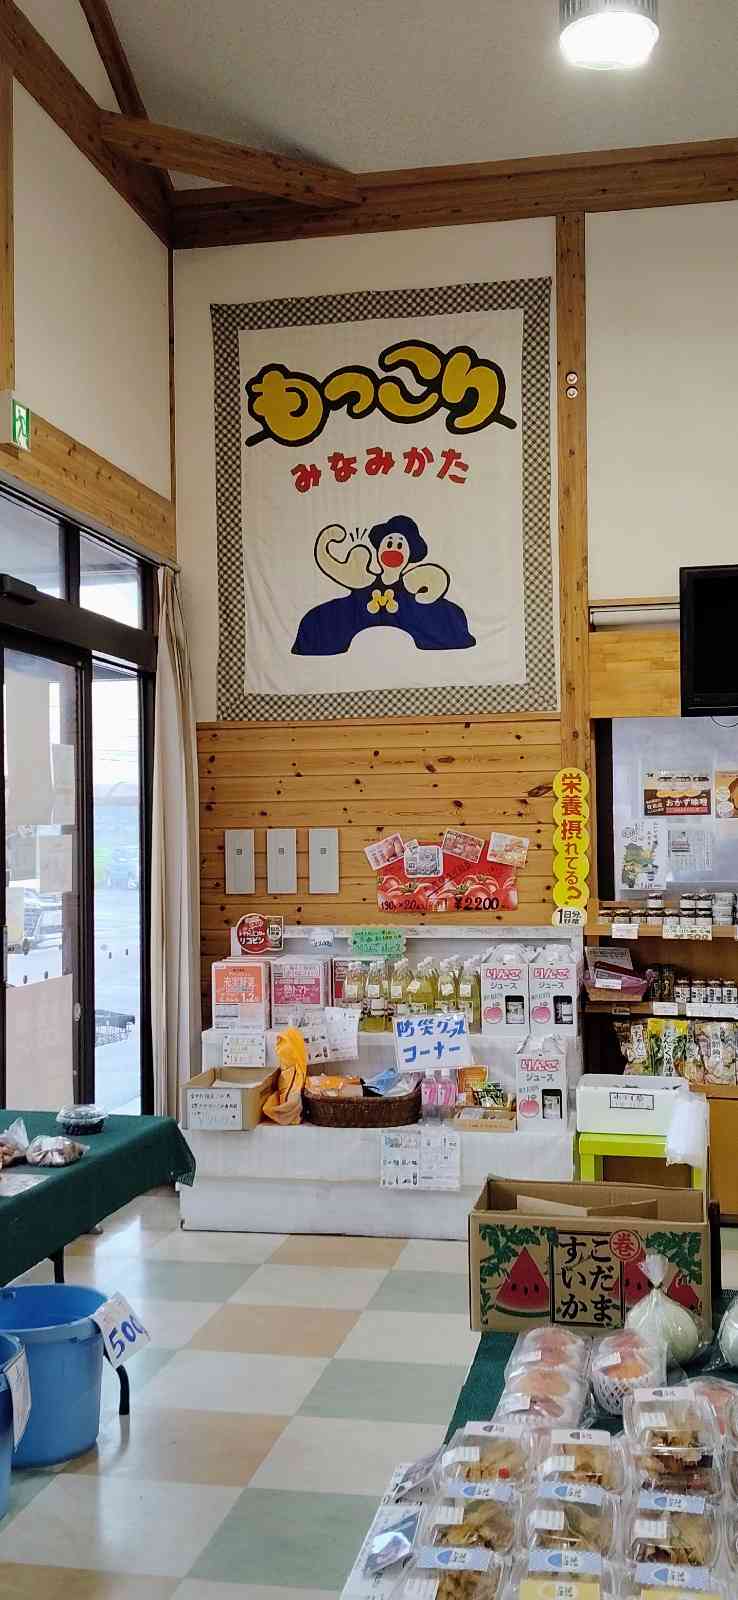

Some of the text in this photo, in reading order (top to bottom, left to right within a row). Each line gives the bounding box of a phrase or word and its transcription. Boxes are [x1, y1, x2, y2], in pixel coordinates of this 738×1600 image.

[245, 340, 516, 447] もっこり
[290, 446, 470, 493] みなみかた
[454, 896, 500, 911] ¥2200
[239, 936, 266, 945] リコピン
[486, 967, 521, 981] りんご
[534, 967, 569, 980] りんご
[489, 982, 518, 990] ジュース
[403, 1040, 461, 1063] コーナー
[520, 1058, 560, 1072] りんご
[525, 1073, 555, 1082] ジュース
[559, 1236, 588, 1321] すいか
[588, 1238, 615, 1323] こだま
